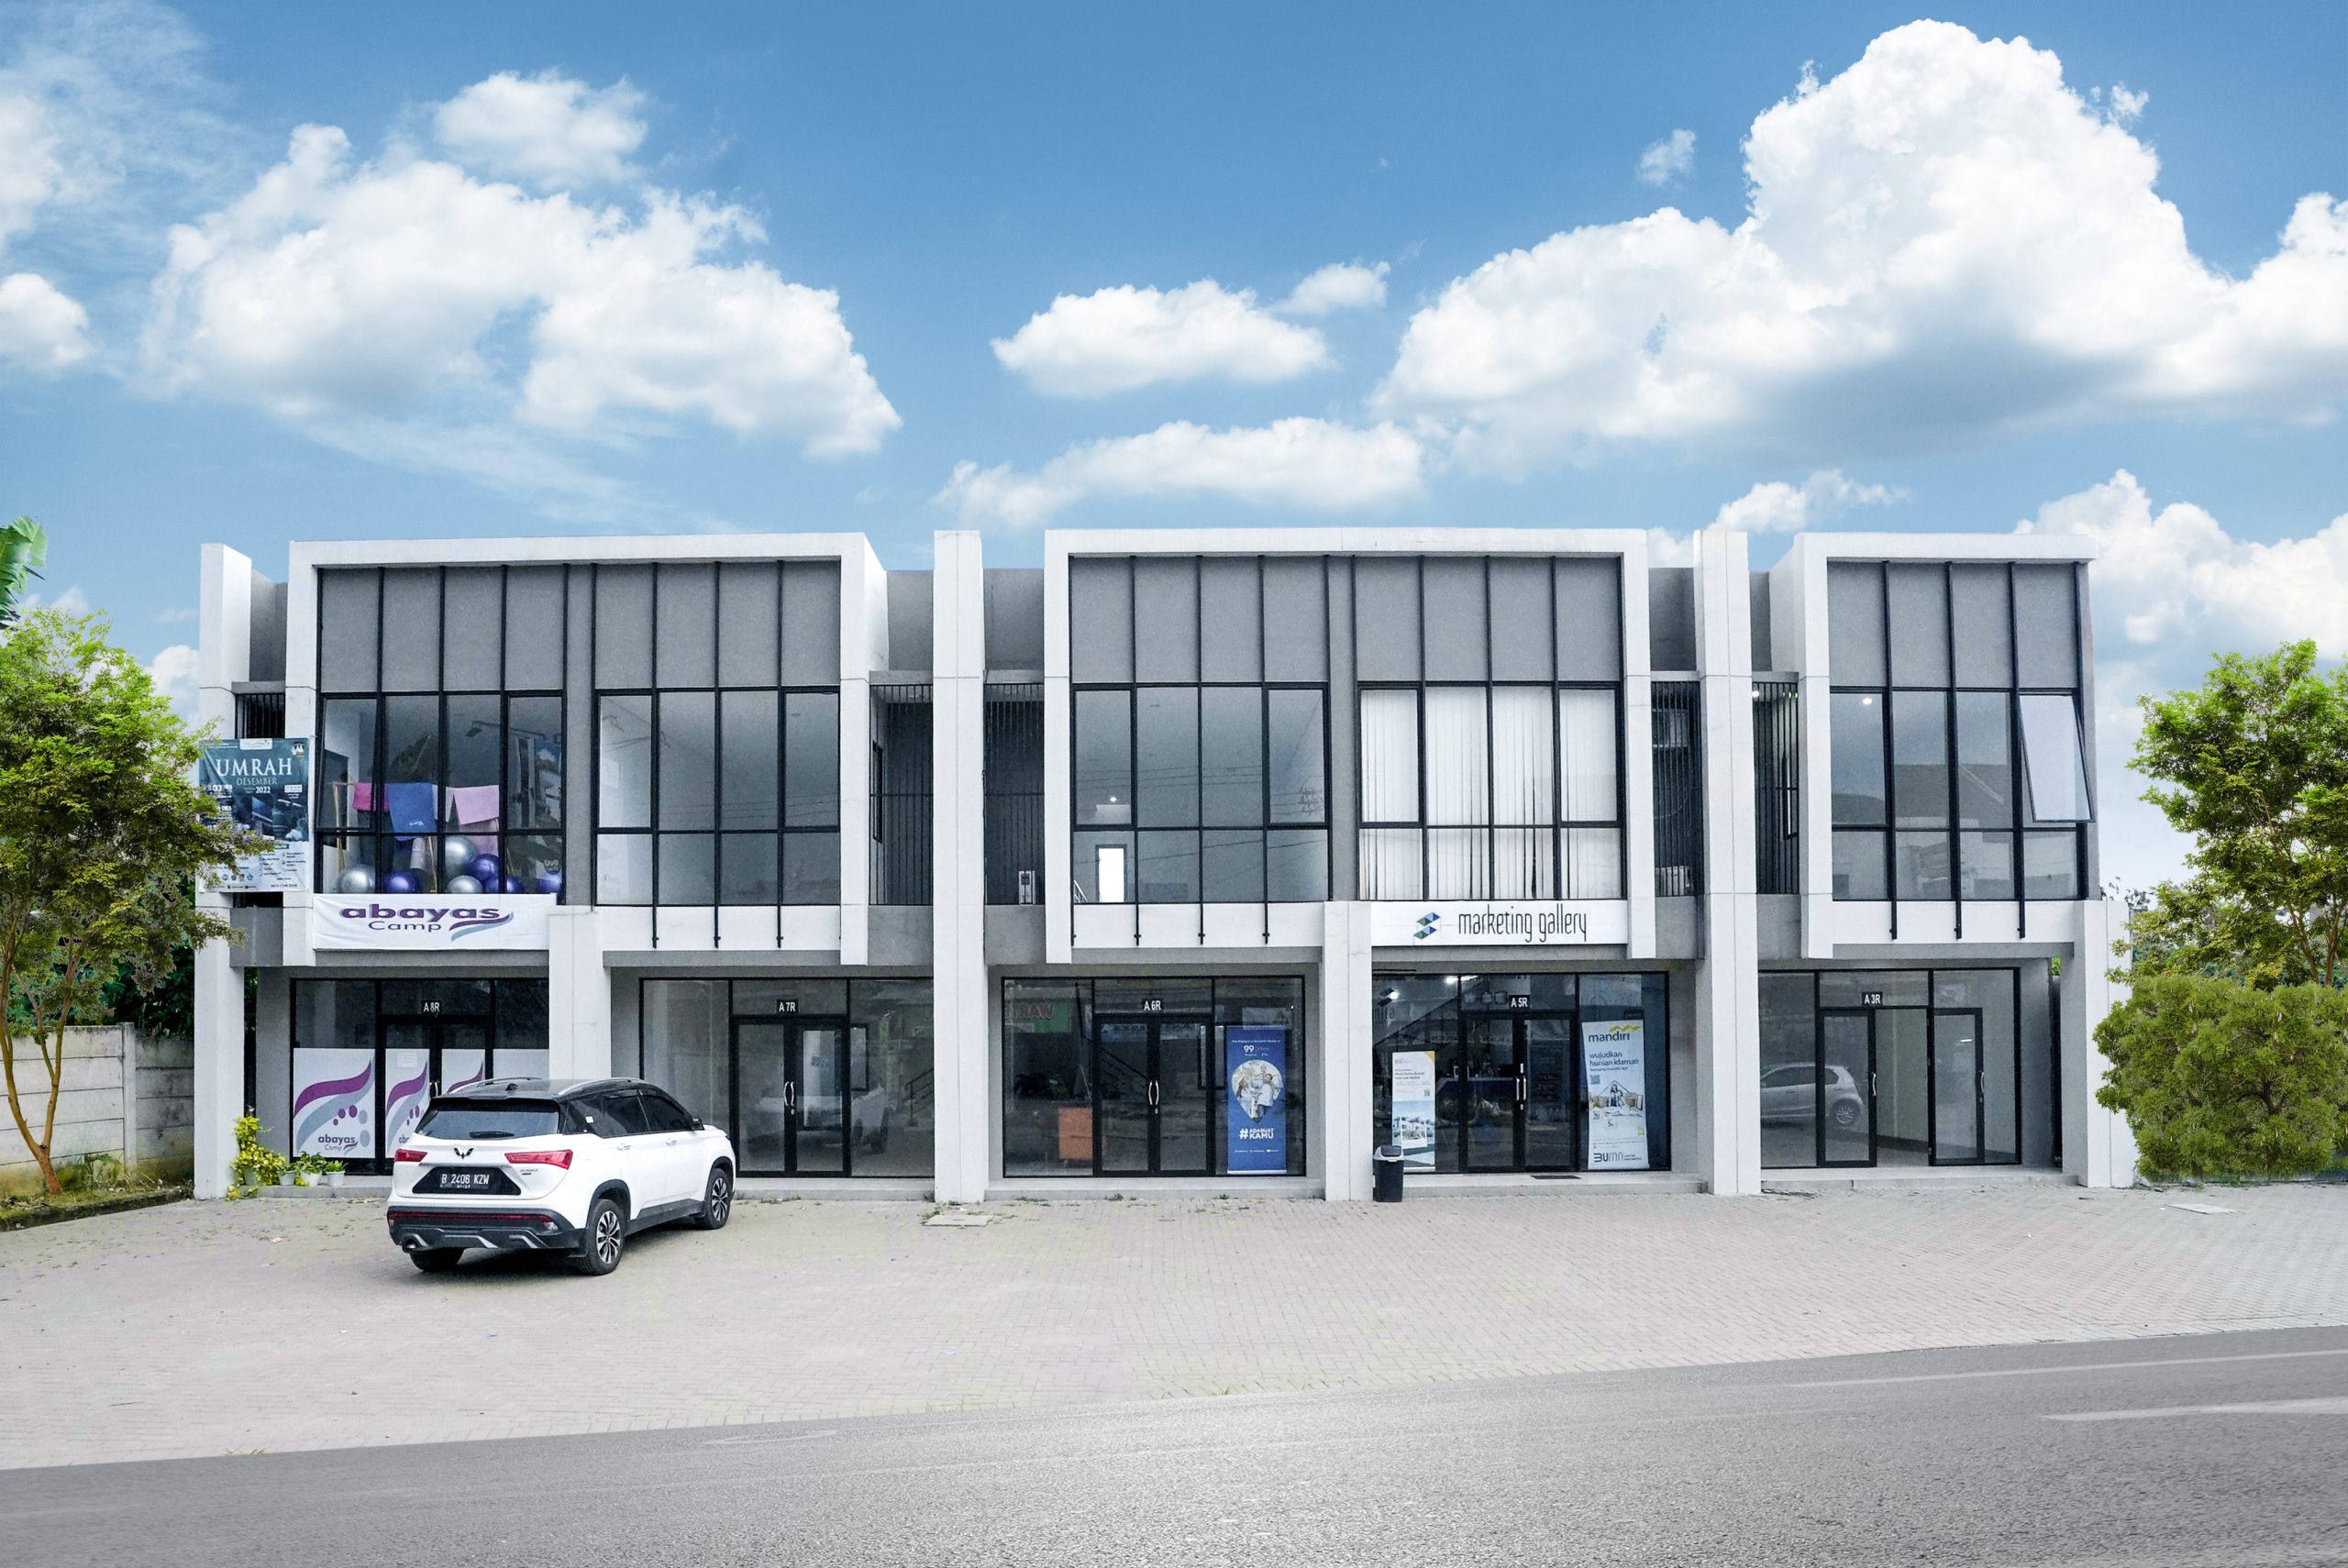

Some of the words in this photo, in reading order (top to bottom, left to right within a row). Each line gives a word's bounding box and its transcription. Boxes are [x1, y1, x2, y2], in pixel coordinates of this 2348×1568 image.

[216, 757, 293, 777] UMRAH
[236, 777, 278, 786] DESEMBER
[255, 786, 271, 794] 2022
[339, 903, 500, 922] abayas
[368, 921, 442, 933] Camp
[1458, 903, 1533, 943] marketing
[1538, 903, 1587, 943] gallery
[1511, 997, 1517, 1008] A
[1518, 997, 1528, 1008] 5R
[1864, 994, 1870, 1004] A
[1870, 993, 1881, 1004] 3R
[423, 1001, 429, 1012] A
[779, 1001, 785, 1012] A
[785, 1001, 796, 1012] 7R
[1144, 999, 1150, 1011] A
[1588, 1031, 1630, 1043] mandiri
[1244, 1044, 1255, 1053] 99
[317, 1134, 356, 1146] abayas
[324, 1143, 342, 1152] Camp
[441, 1174, 448, 1184] B
[450, 1174, 471, 1184] 2406
[473, 1175, 490, 1185] KZW
